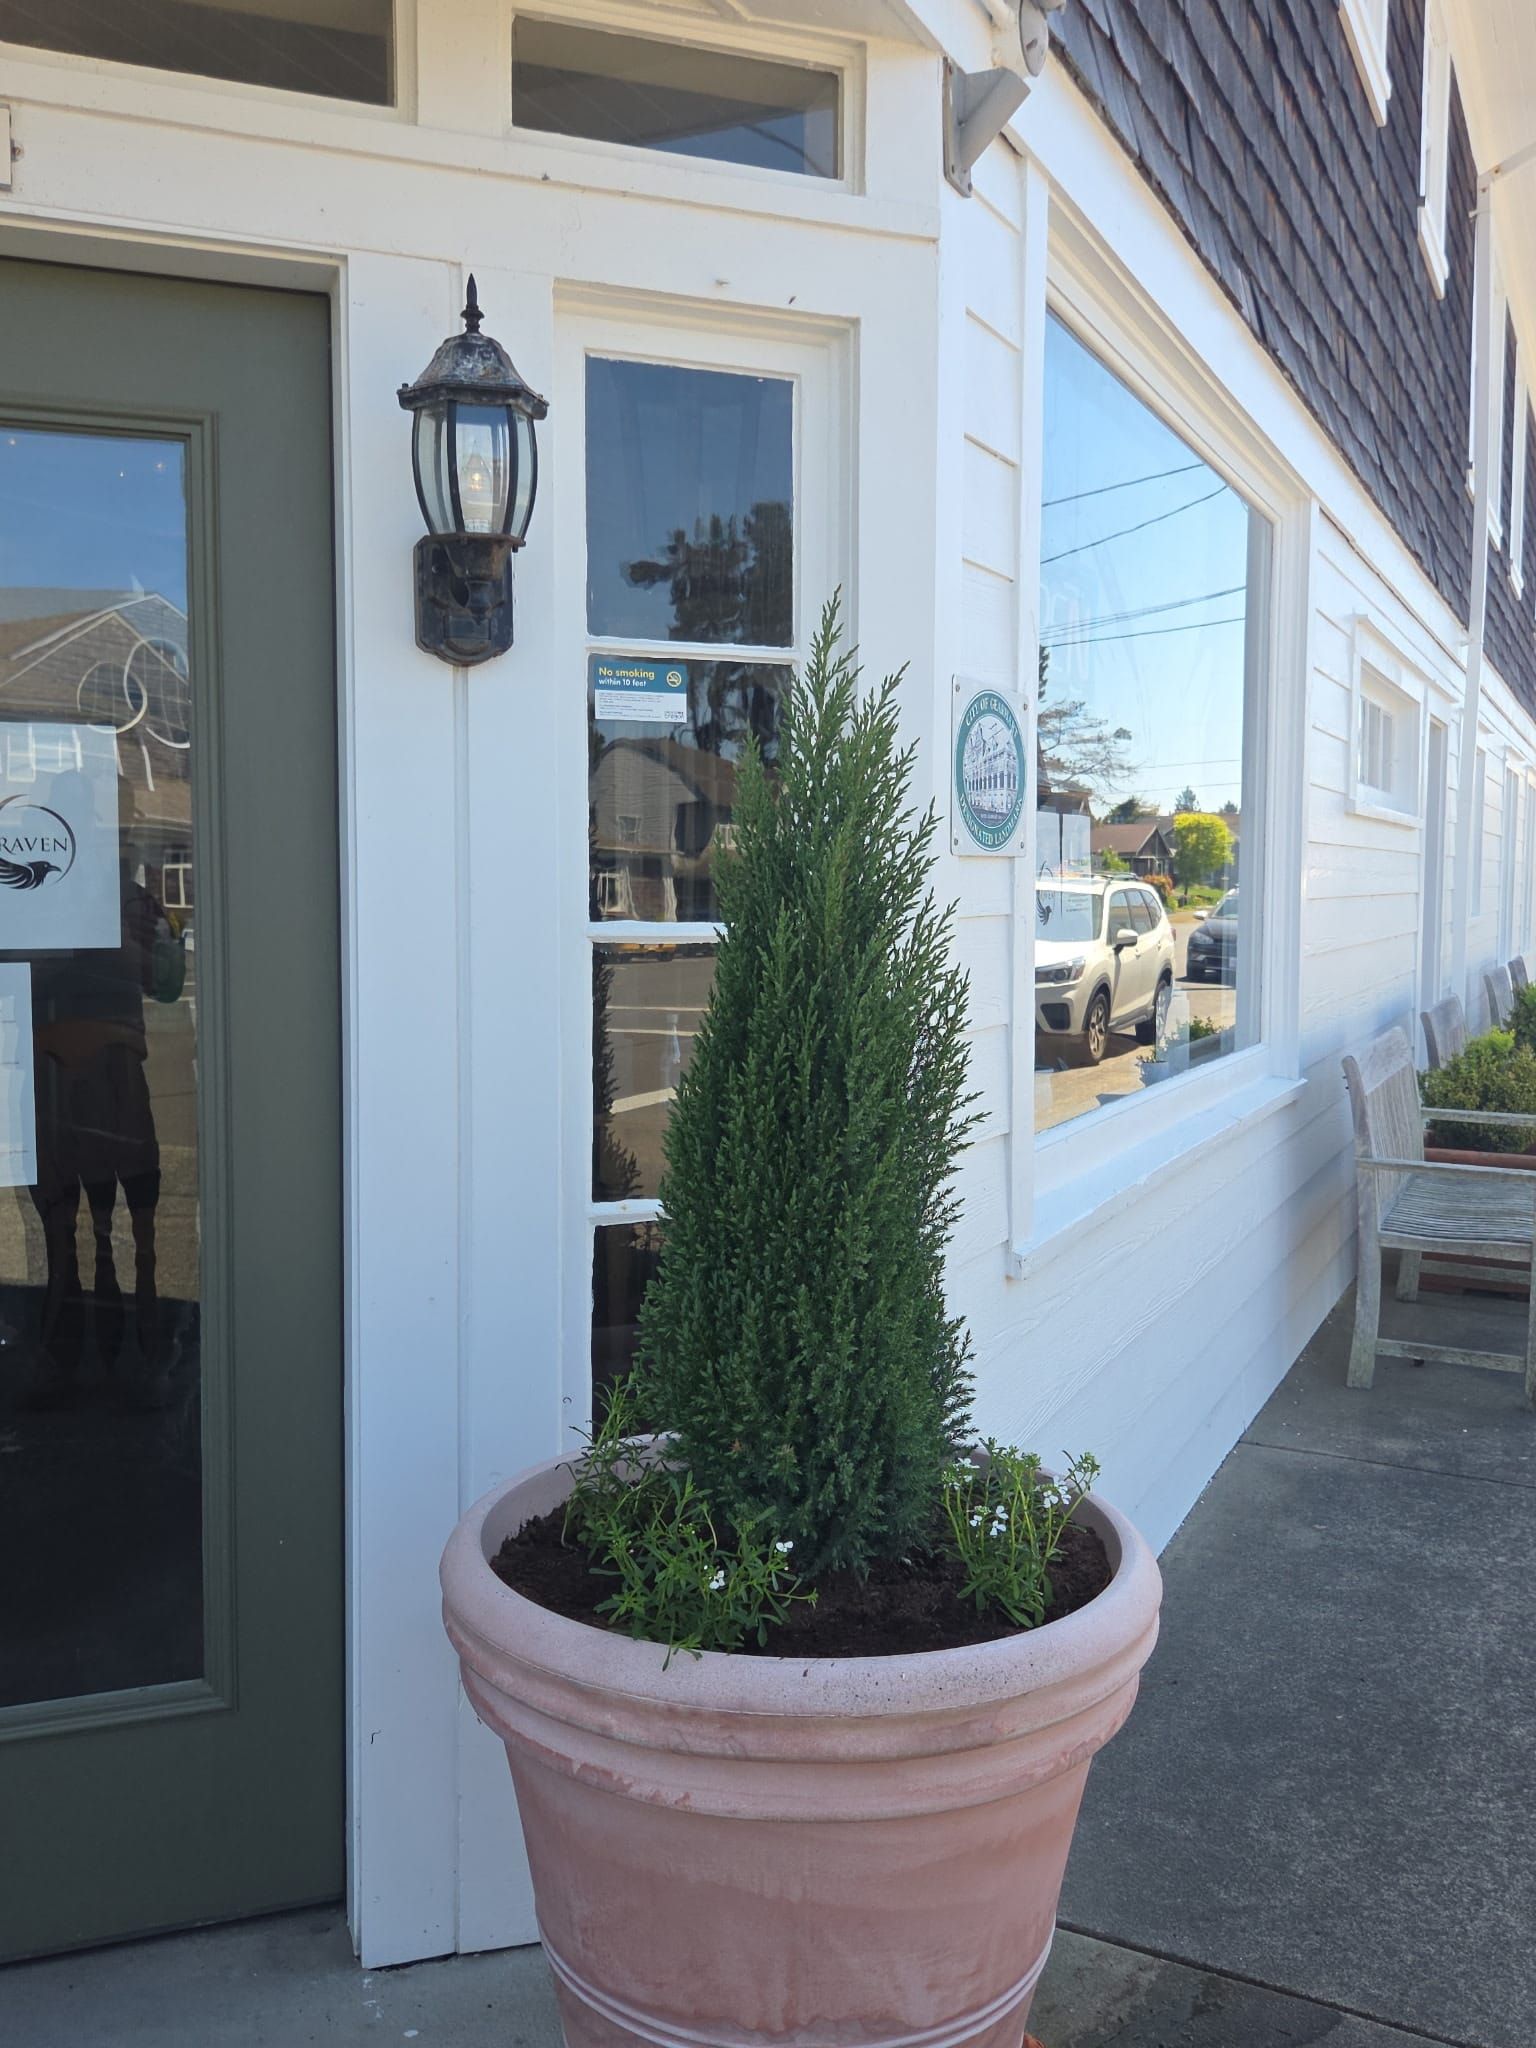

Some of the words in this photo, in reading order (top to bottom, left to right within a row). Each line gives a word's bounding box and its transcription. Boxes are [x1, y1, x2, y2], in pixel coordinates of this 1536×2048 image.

[599, 667, 613, 676] No
[615, 668, 655, 681] smoking
[598, 677, 621, 686] within
[632, 678, 647, 687] feet
[981, 697, 990, 709] OF
[960, 793, 993, 845] DESIGNATED
[994, 798, 1023, 845] LANDMARK
[0, 837, 68, 855] RAVEN
